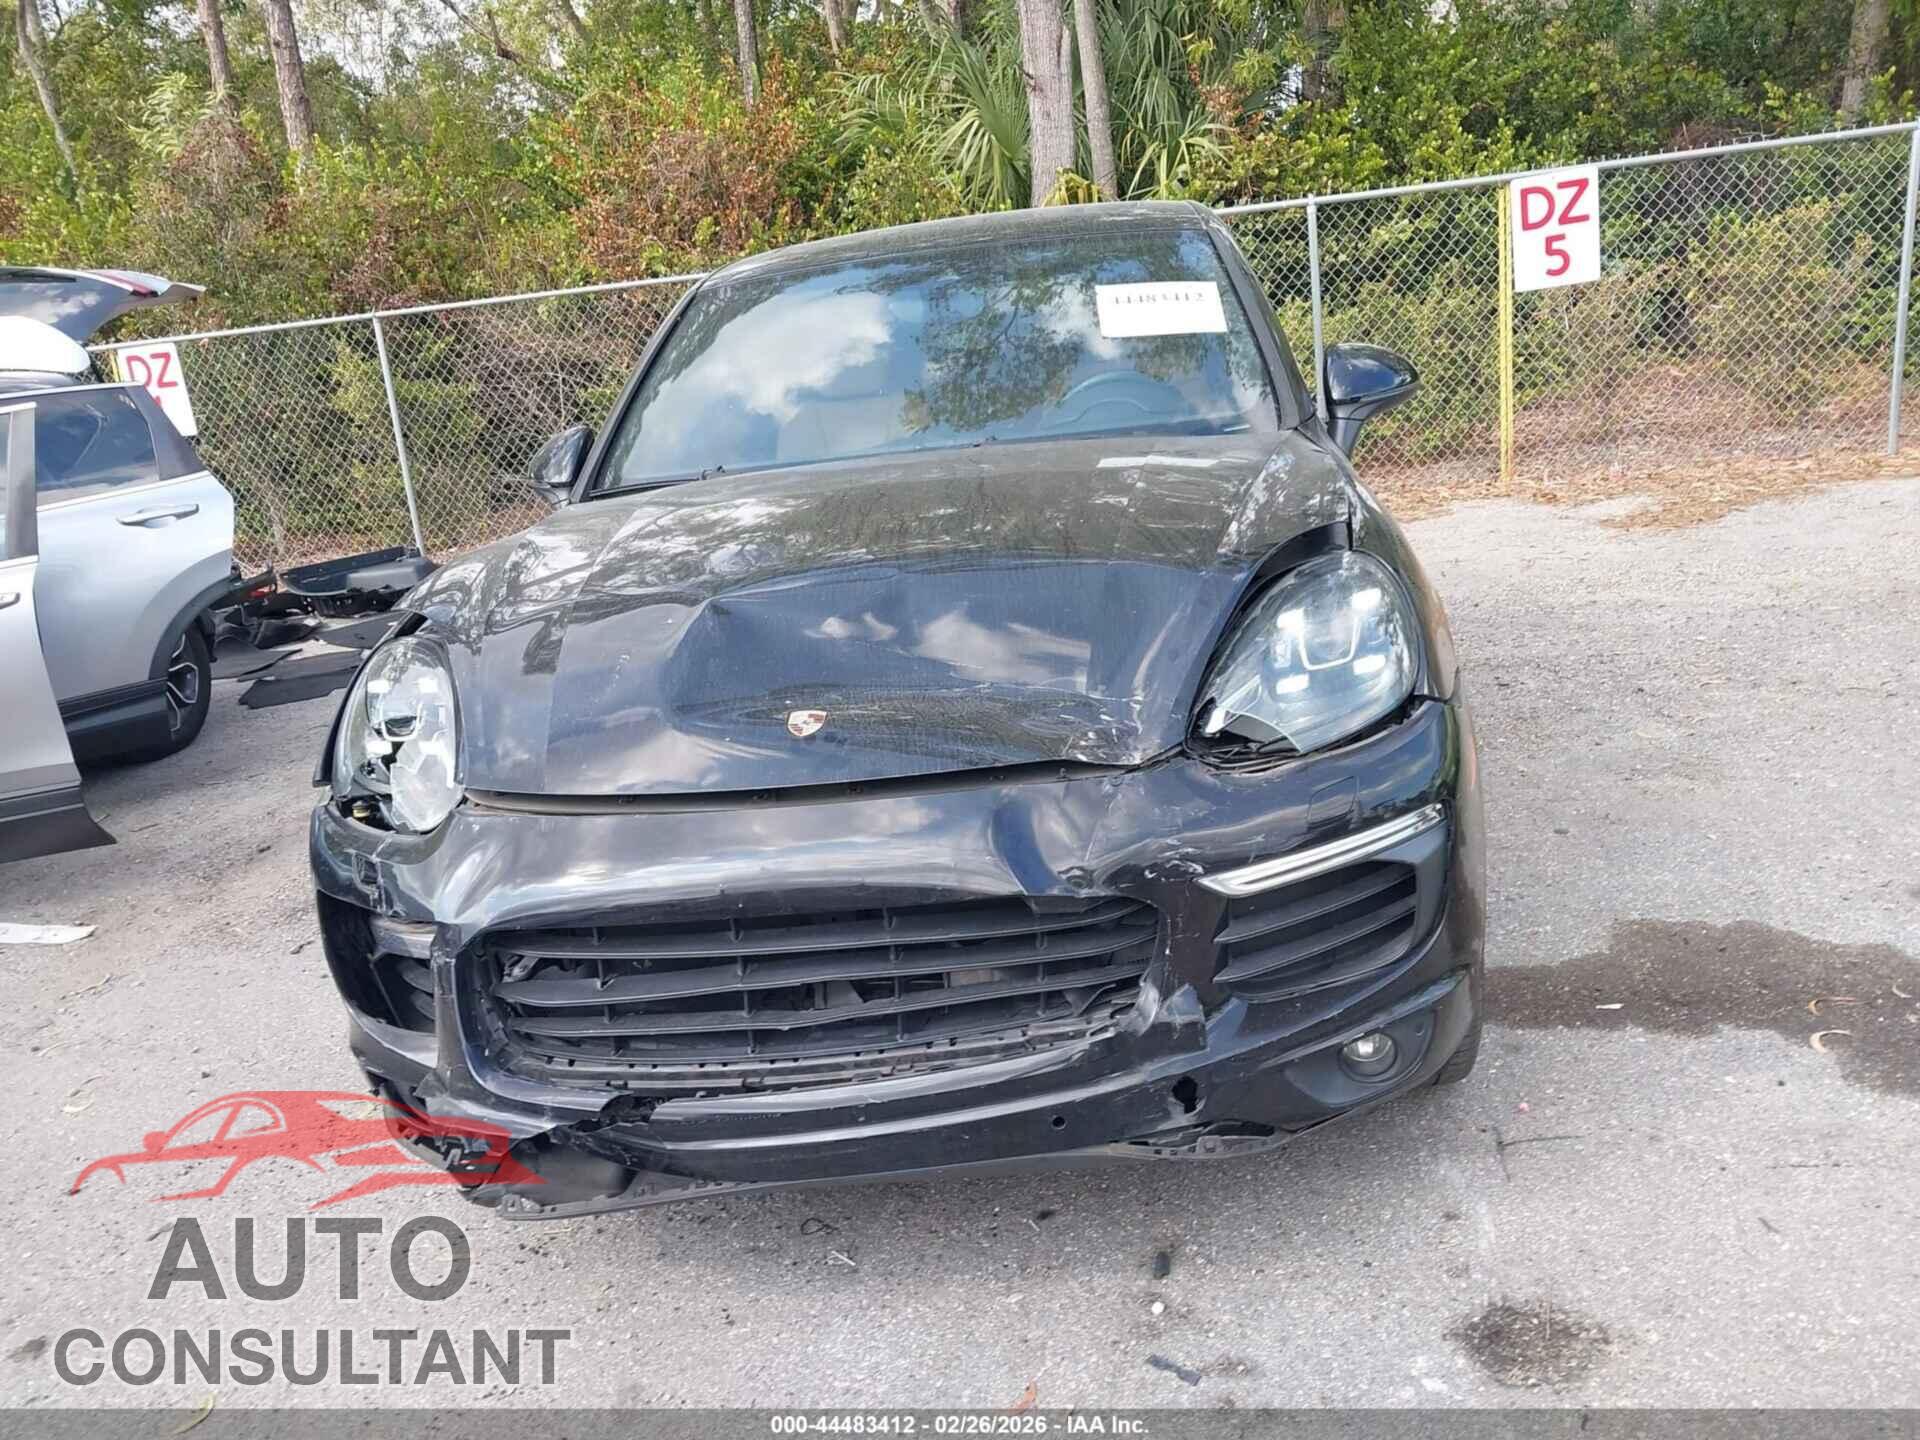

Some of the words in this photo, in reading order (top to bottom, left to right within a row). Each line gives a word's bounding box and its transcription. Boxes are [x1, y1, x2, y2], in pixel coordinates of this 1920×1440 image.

[1520, 178, 1590, 231] DZ
[1545, 233, 1571, 276] 5
[126, 352, 178, 390] DZ
